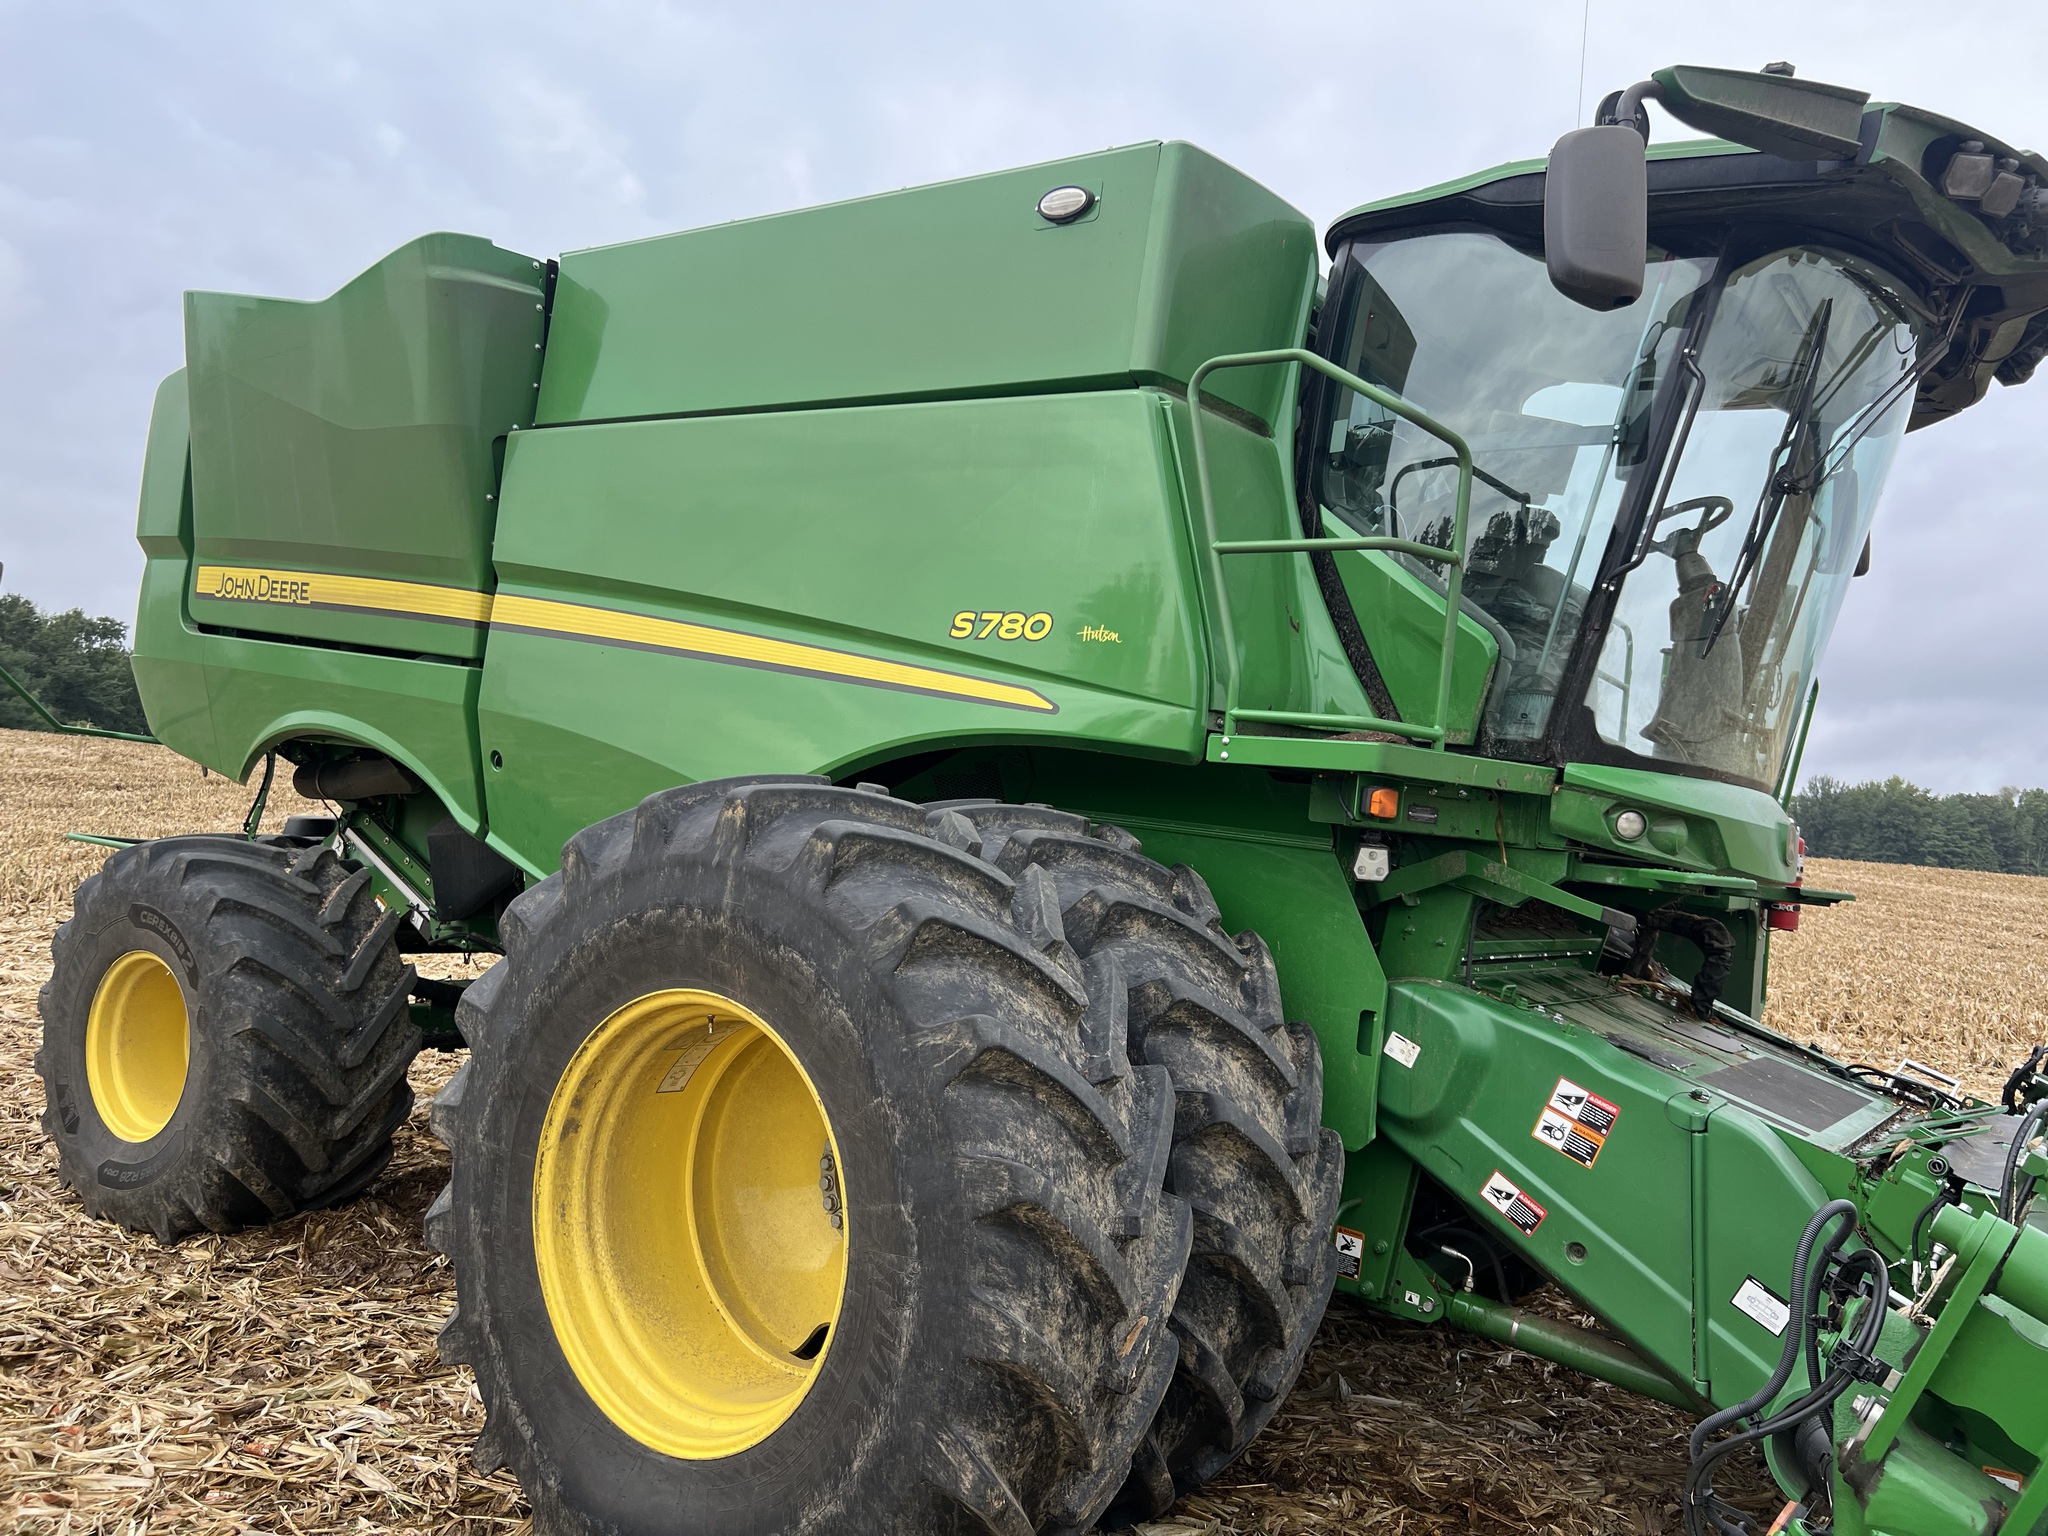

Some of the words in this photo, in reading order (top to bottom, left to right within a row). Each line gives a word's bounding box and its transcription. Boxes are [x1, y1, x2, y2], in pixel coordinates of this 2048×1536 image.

[215, 573, 255, 597] JOHN
[258, 575, 310, 601] DEERE
[948, 610, 1054, 642] S780
[1076, 624, 1123, 644] Hutson
[140, 910, 185, 955] CEREXBIB
[181, 951, 195, 972] 2
[1593, 1098, 1618, 1113] DANGER
[1577, 1127, 1602, 1144] WARNING
[1523, 1196, 1545, 1217] DANGER
